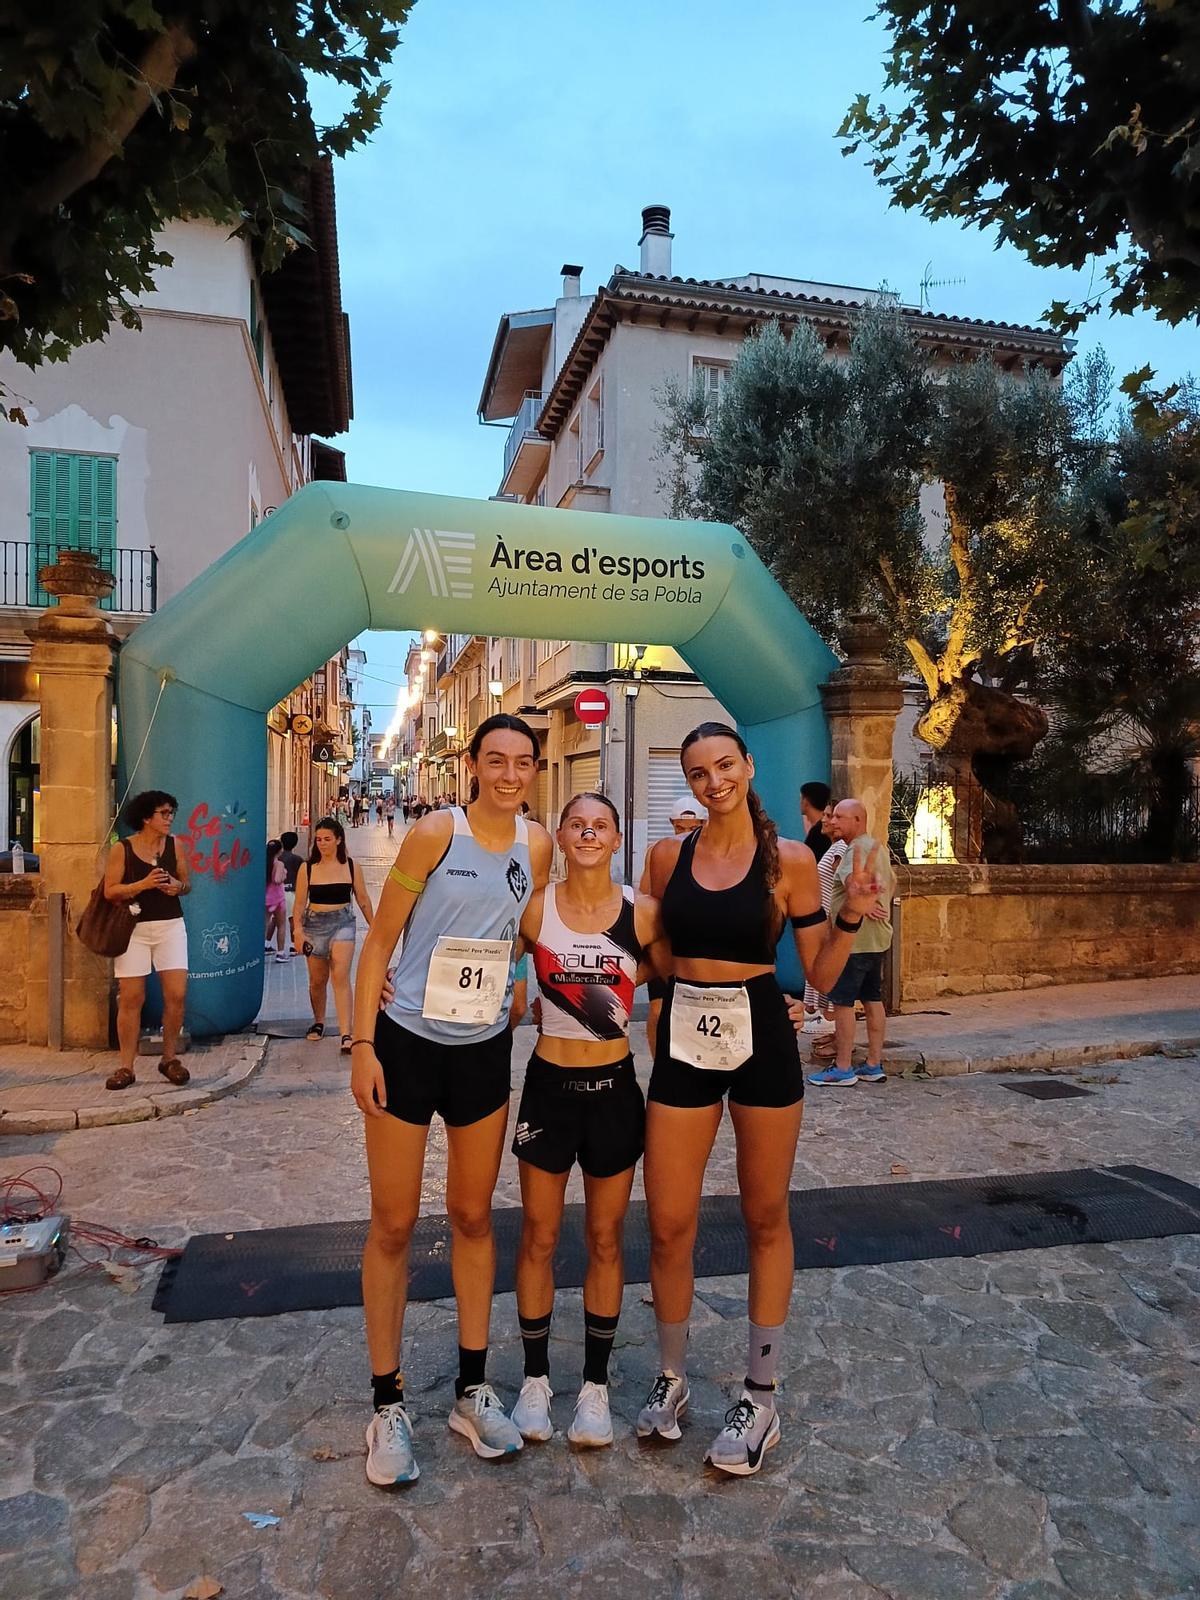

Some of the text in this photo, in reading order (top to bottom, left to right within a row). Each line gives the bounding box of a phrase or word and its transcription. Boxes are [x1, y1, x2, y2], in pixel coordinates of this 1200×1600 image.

[489, 534, 705, 584] Àrea d'esports
[487, 577, 702, 604] Ajuntament de sa Pobla
[225, 967, 236, 976] de
[458, 966, 483, 989] 81
[696, 1014, 721, 1038] 42
